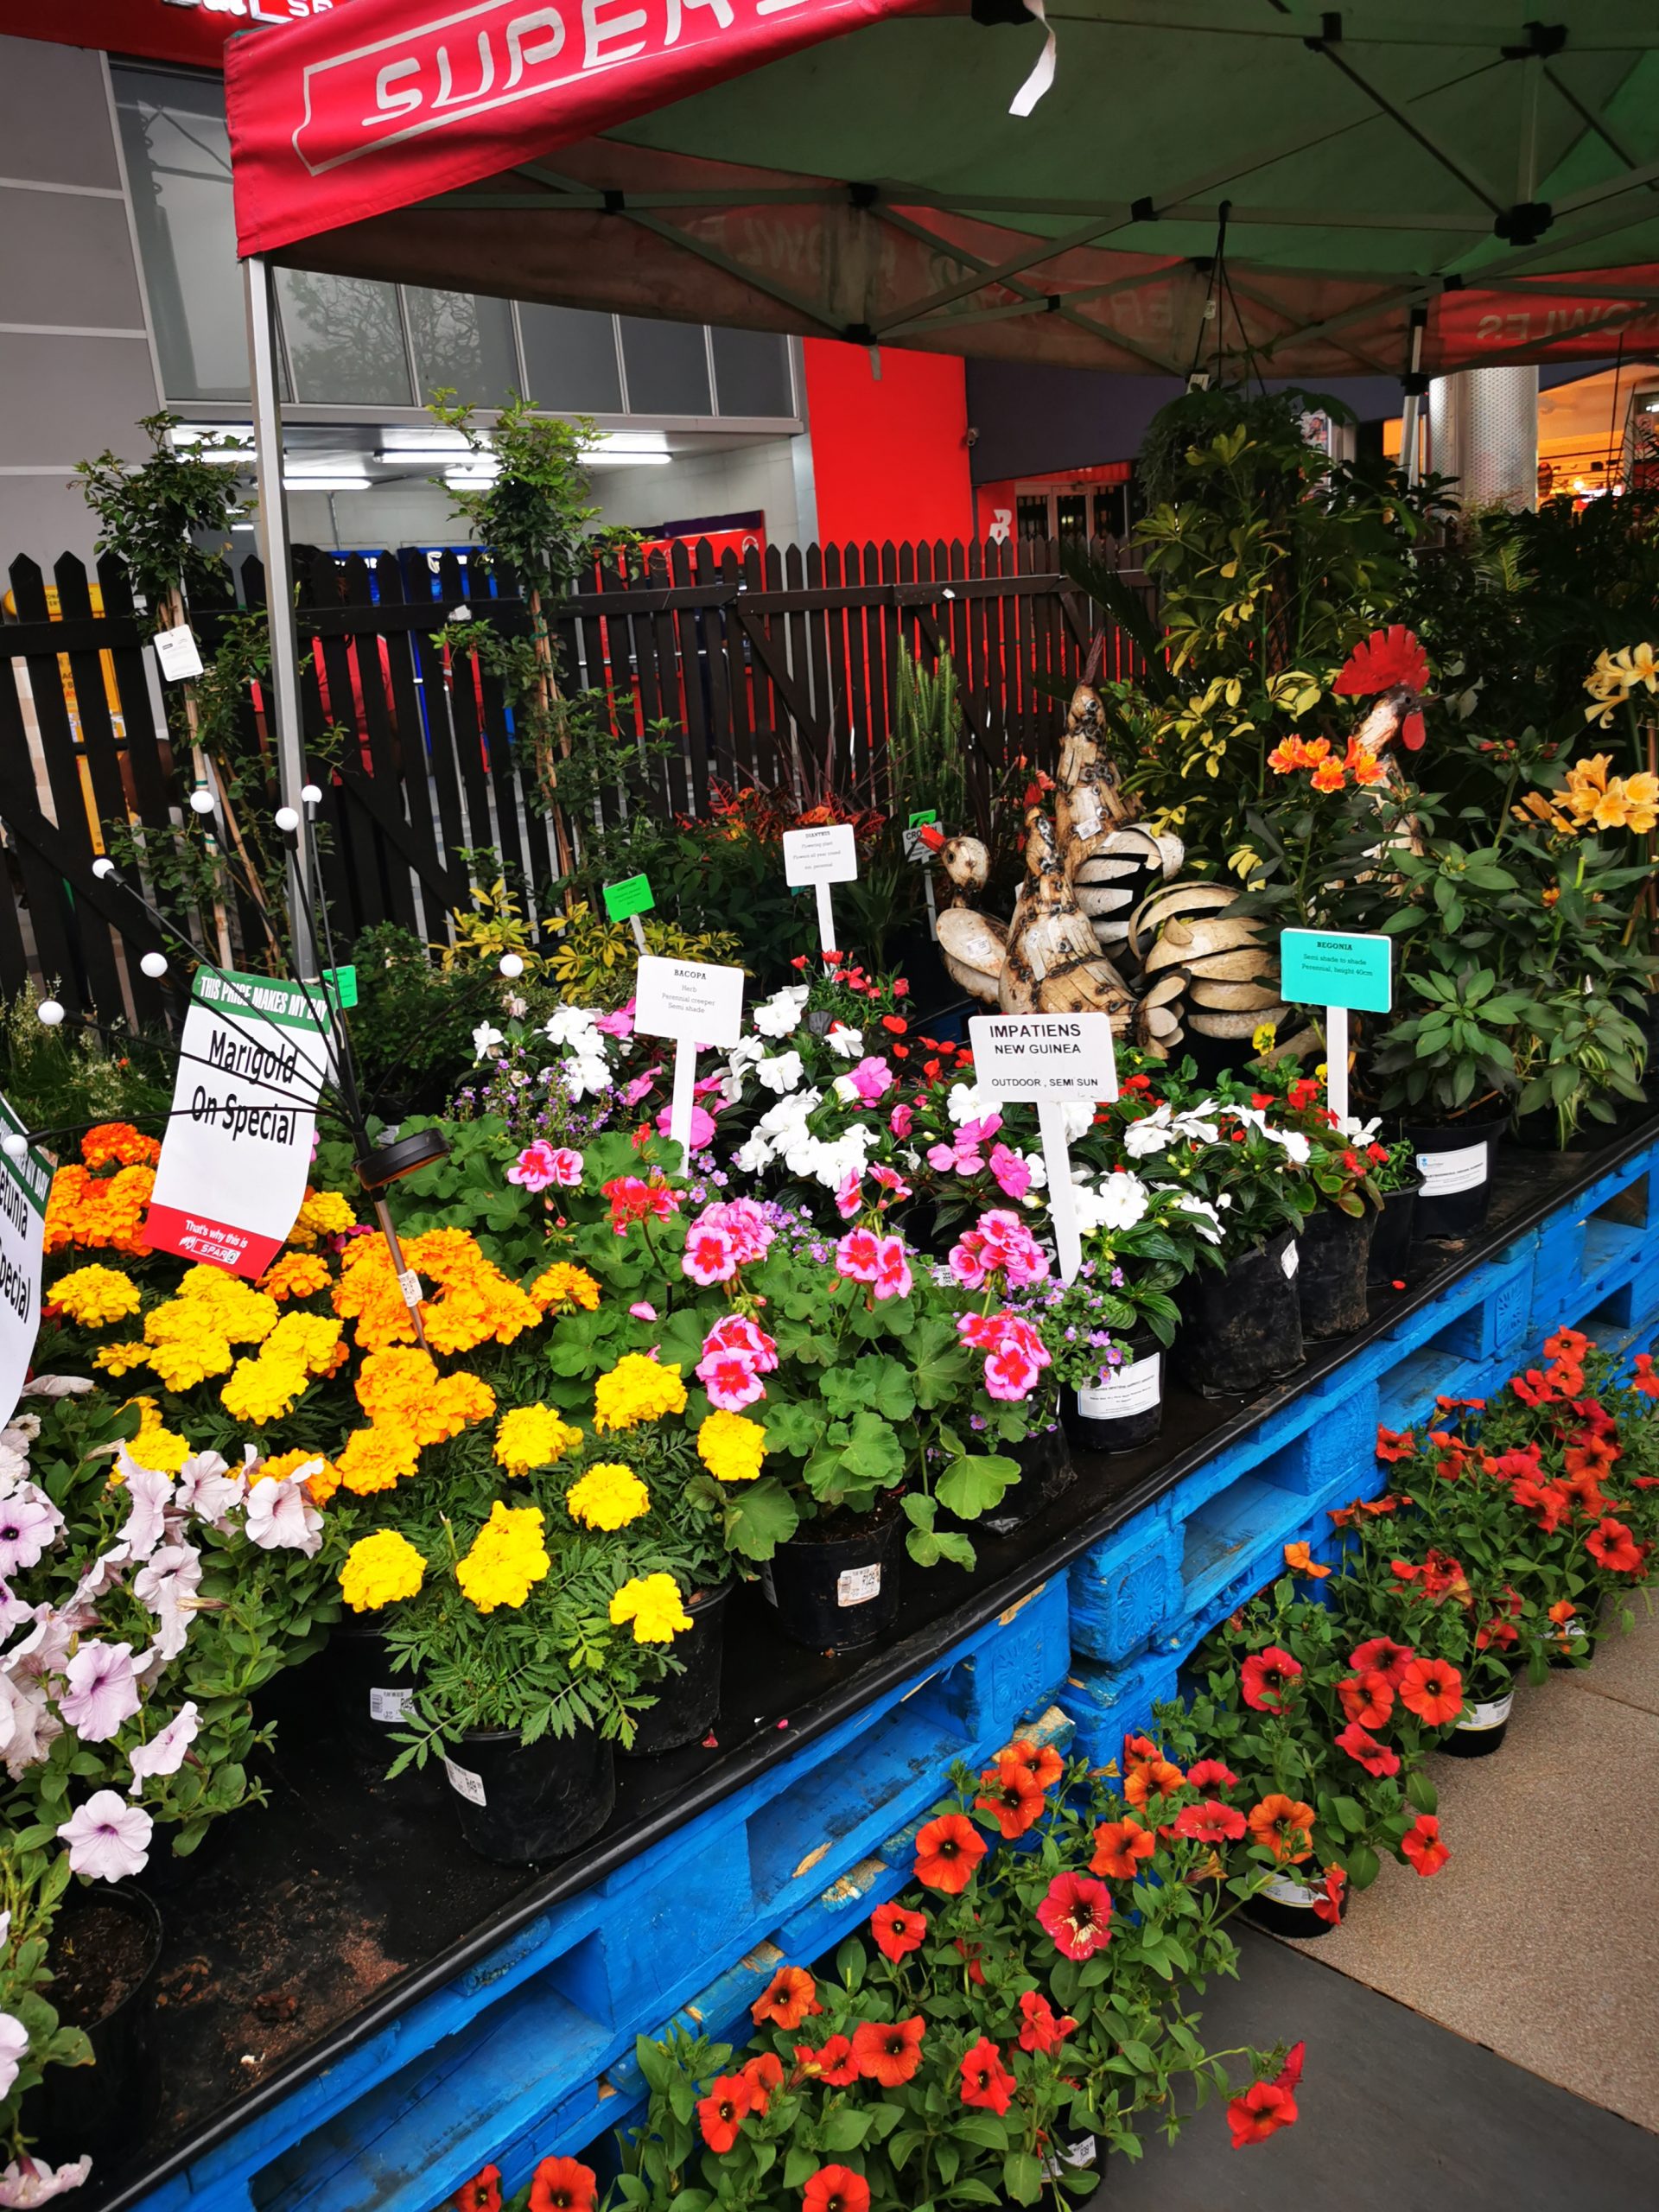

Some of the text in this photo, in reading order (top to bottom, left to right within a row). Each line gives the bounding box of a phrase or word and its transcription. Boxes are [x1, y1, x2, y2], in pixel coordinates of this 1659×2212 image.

[1317, 941, 1353, 951] BEGONIA
[674, 969, 707, 980] BACOPA
[200, 976, 327, 1022] THIS PRICE MAKES MY DAY
[662, 993, 715, 1007] Perennial creeper
[668, 1002, 705, 1014] Semi shade
[990, 1024, 1081, 1038] IMPATIENS
[995, 1044, 1081, 1054] NEW GUINEA
[209, 1030, 298, 1085] Marigold
[992, 1078, 1040, 1087] OUTDOOR
[192, 1086, 297, 1146] On Special
[186, 1219, 248, 1249] That's why this is
[200, 1244, 230, 1260] SPAR
